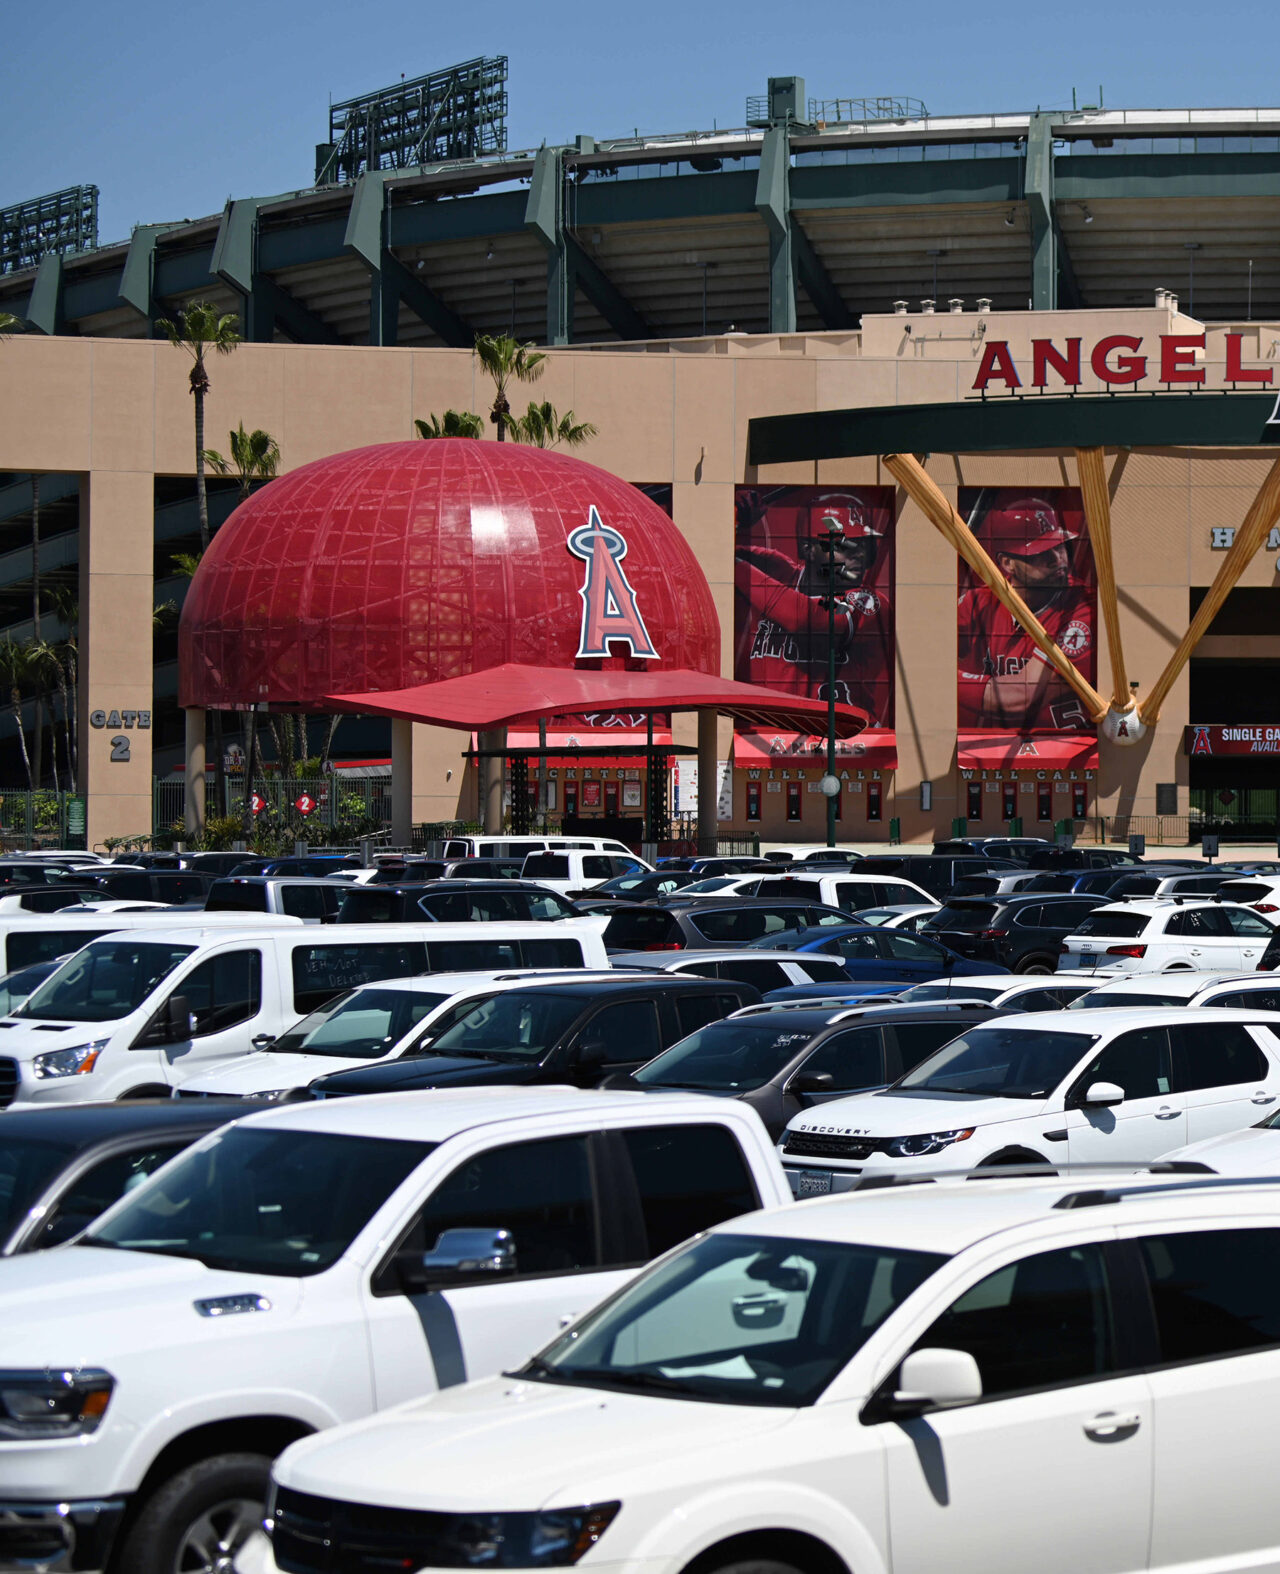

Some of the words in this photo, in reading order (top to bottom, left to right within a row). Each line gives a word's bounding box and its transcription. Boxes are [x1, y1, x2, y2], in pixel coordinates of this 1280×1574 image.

[972, 332, 1273, 390] ANGEL
[567, 504, 661, 659] A
[91, 709, 151, 729] GATE
[1222, 729, 1262, 741] SINGLE
[110, 735, 130, 762] 2
[749, 770, 806, 779] WILL
[962, 770, 1018, 780] WILL
[1037, 770, 1093, 780] CALL
[301, 796, 310, 810] 2
[800, 1124, 872, 1136] DISCOVERY
